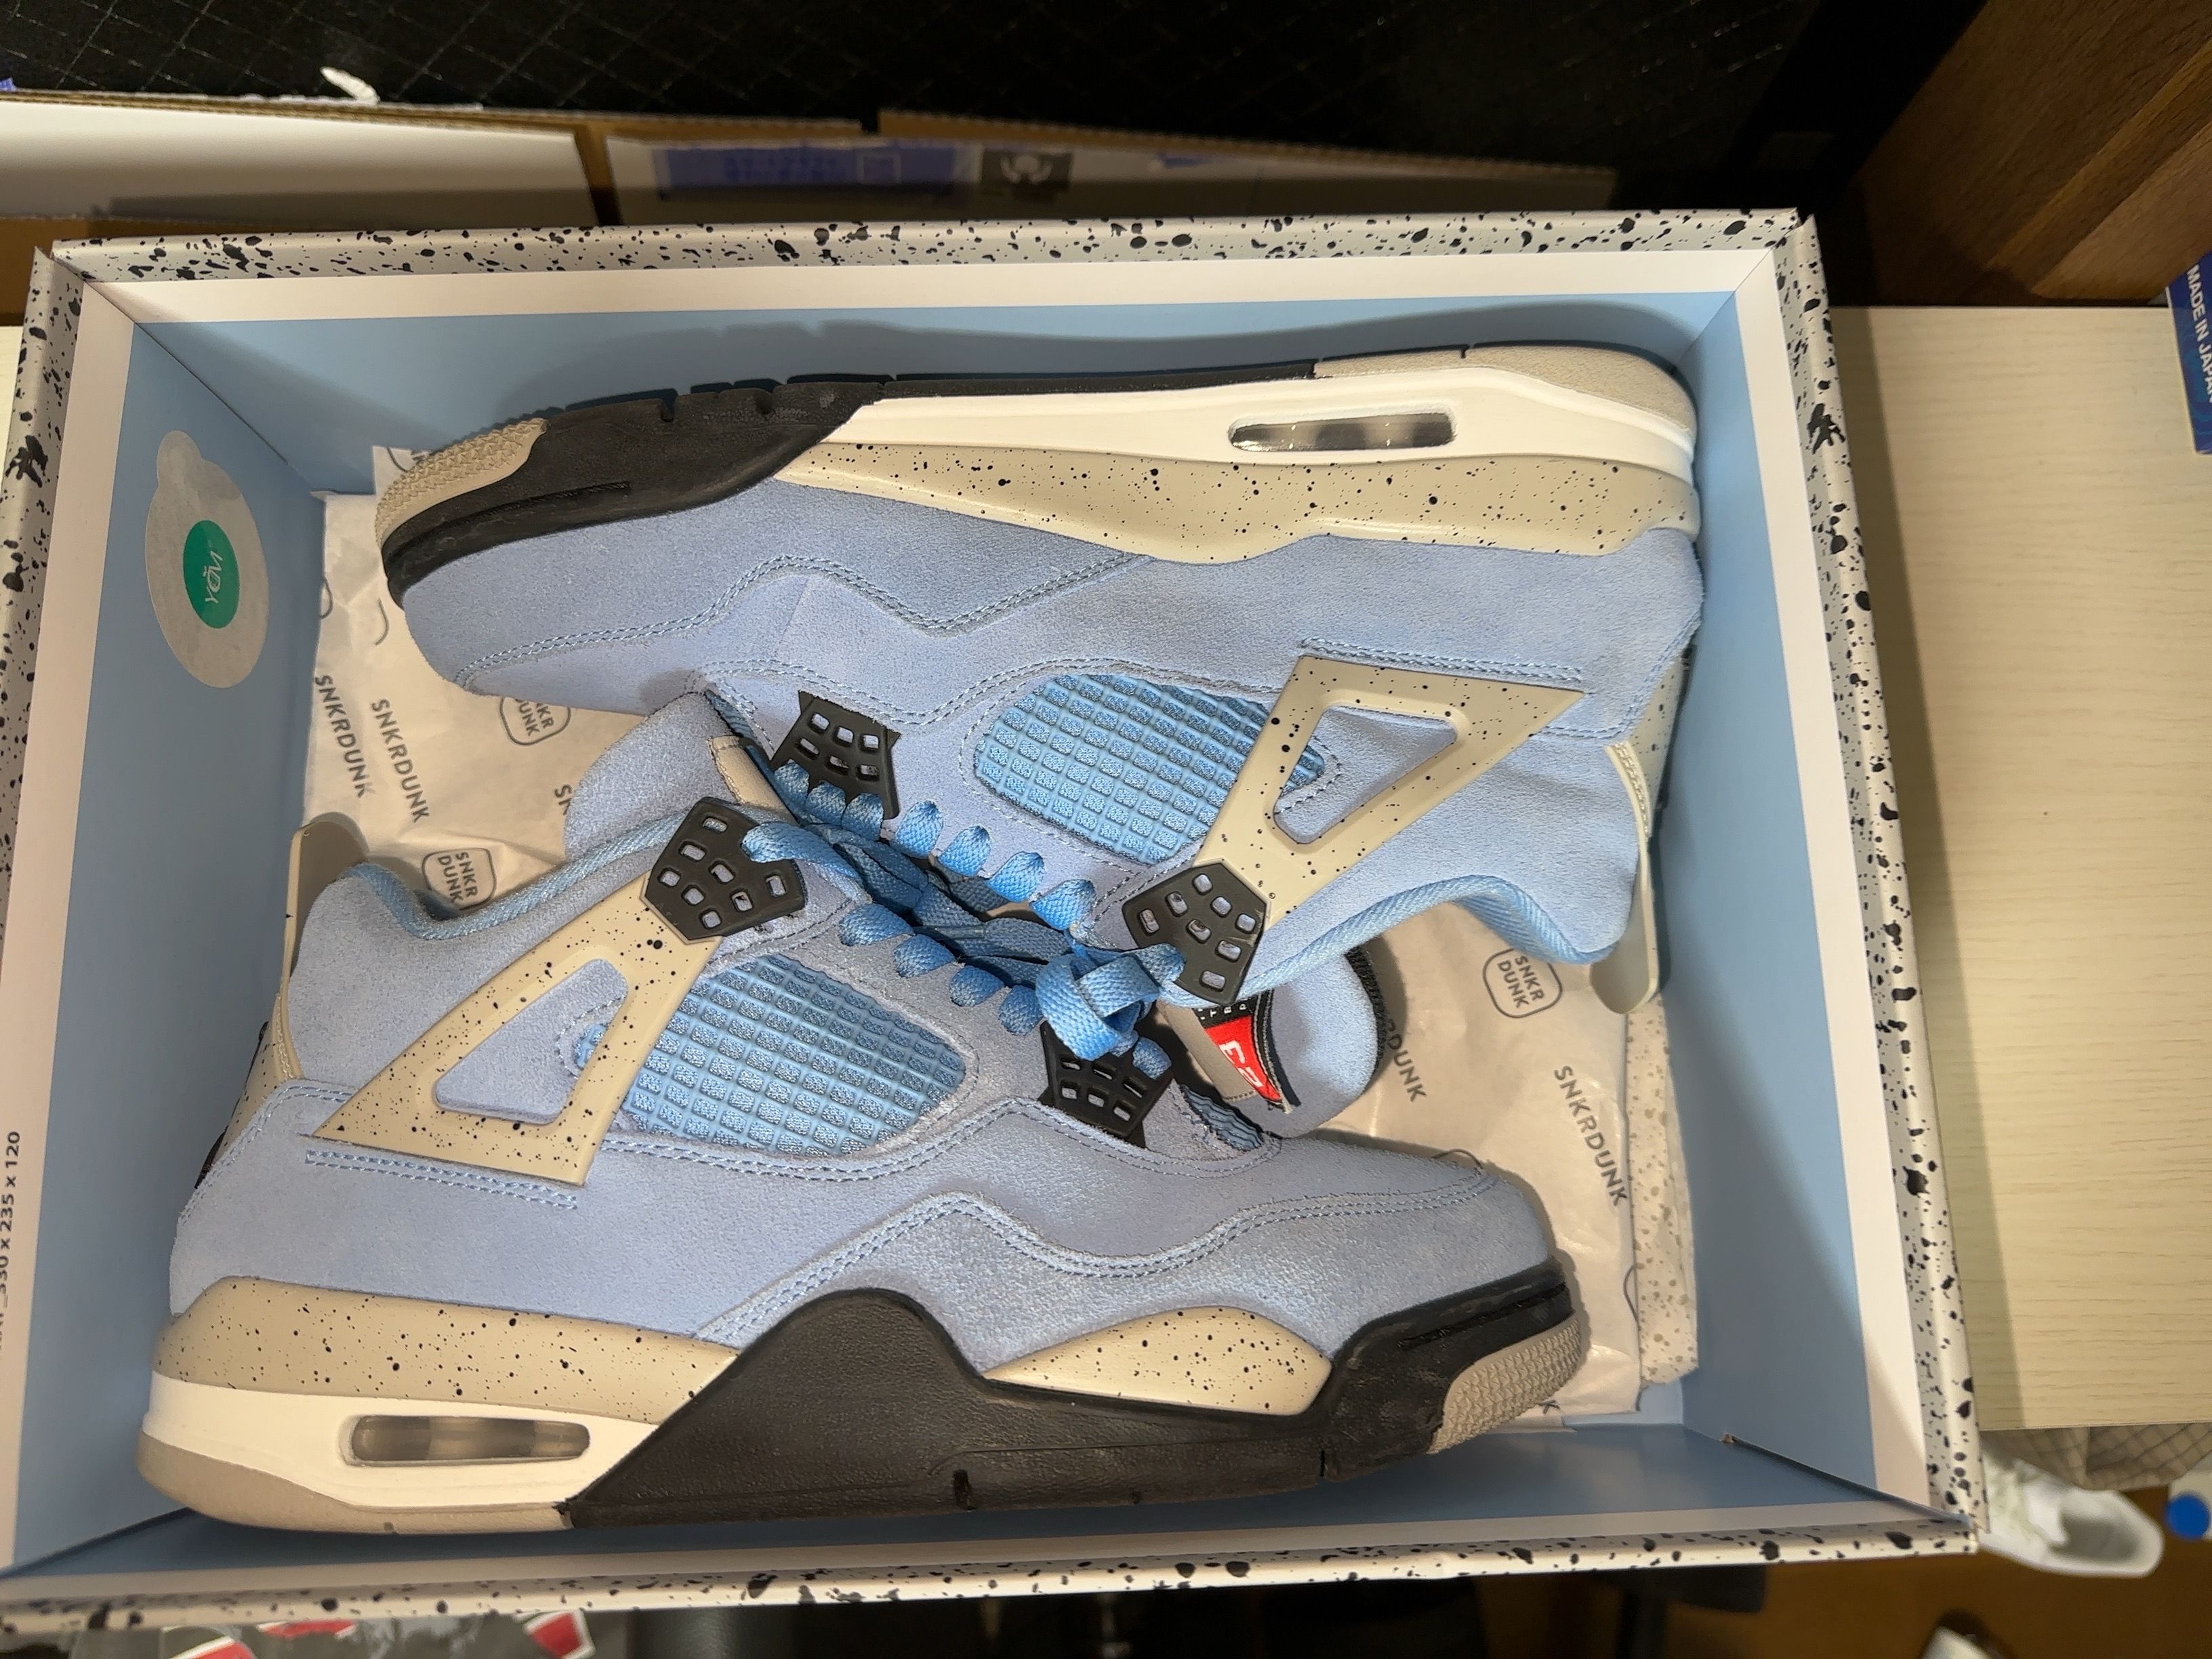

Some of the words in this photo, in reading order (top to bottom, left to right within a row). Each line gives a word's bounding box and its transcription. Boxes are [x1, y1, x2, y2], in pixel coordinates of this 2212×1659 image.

[2186, 264, 2205, 321] MADE
[2194, 318, 2209, 342] IN
[2198, 343, 2212, 403] JAPA
[314, 675, 375, 798] SNKRDUNK
[515, 699, 541, 737] UNK
[535, 703, 554, 729] KR
[371, 699, 430, 823] SNKRDUNK
[438, 855, 464, 903] DUNK
[455, 851, 478, 898] SNKR
[1497, 960, 1530, 1008] DUNK
[1515, 956, 1544, 1001] SNKR
[5, 1130, 21, 1169] 120
[1553, 1065, 1628, 1207] SNKRDUNK
[0, 1193, 15, 1233] 235
